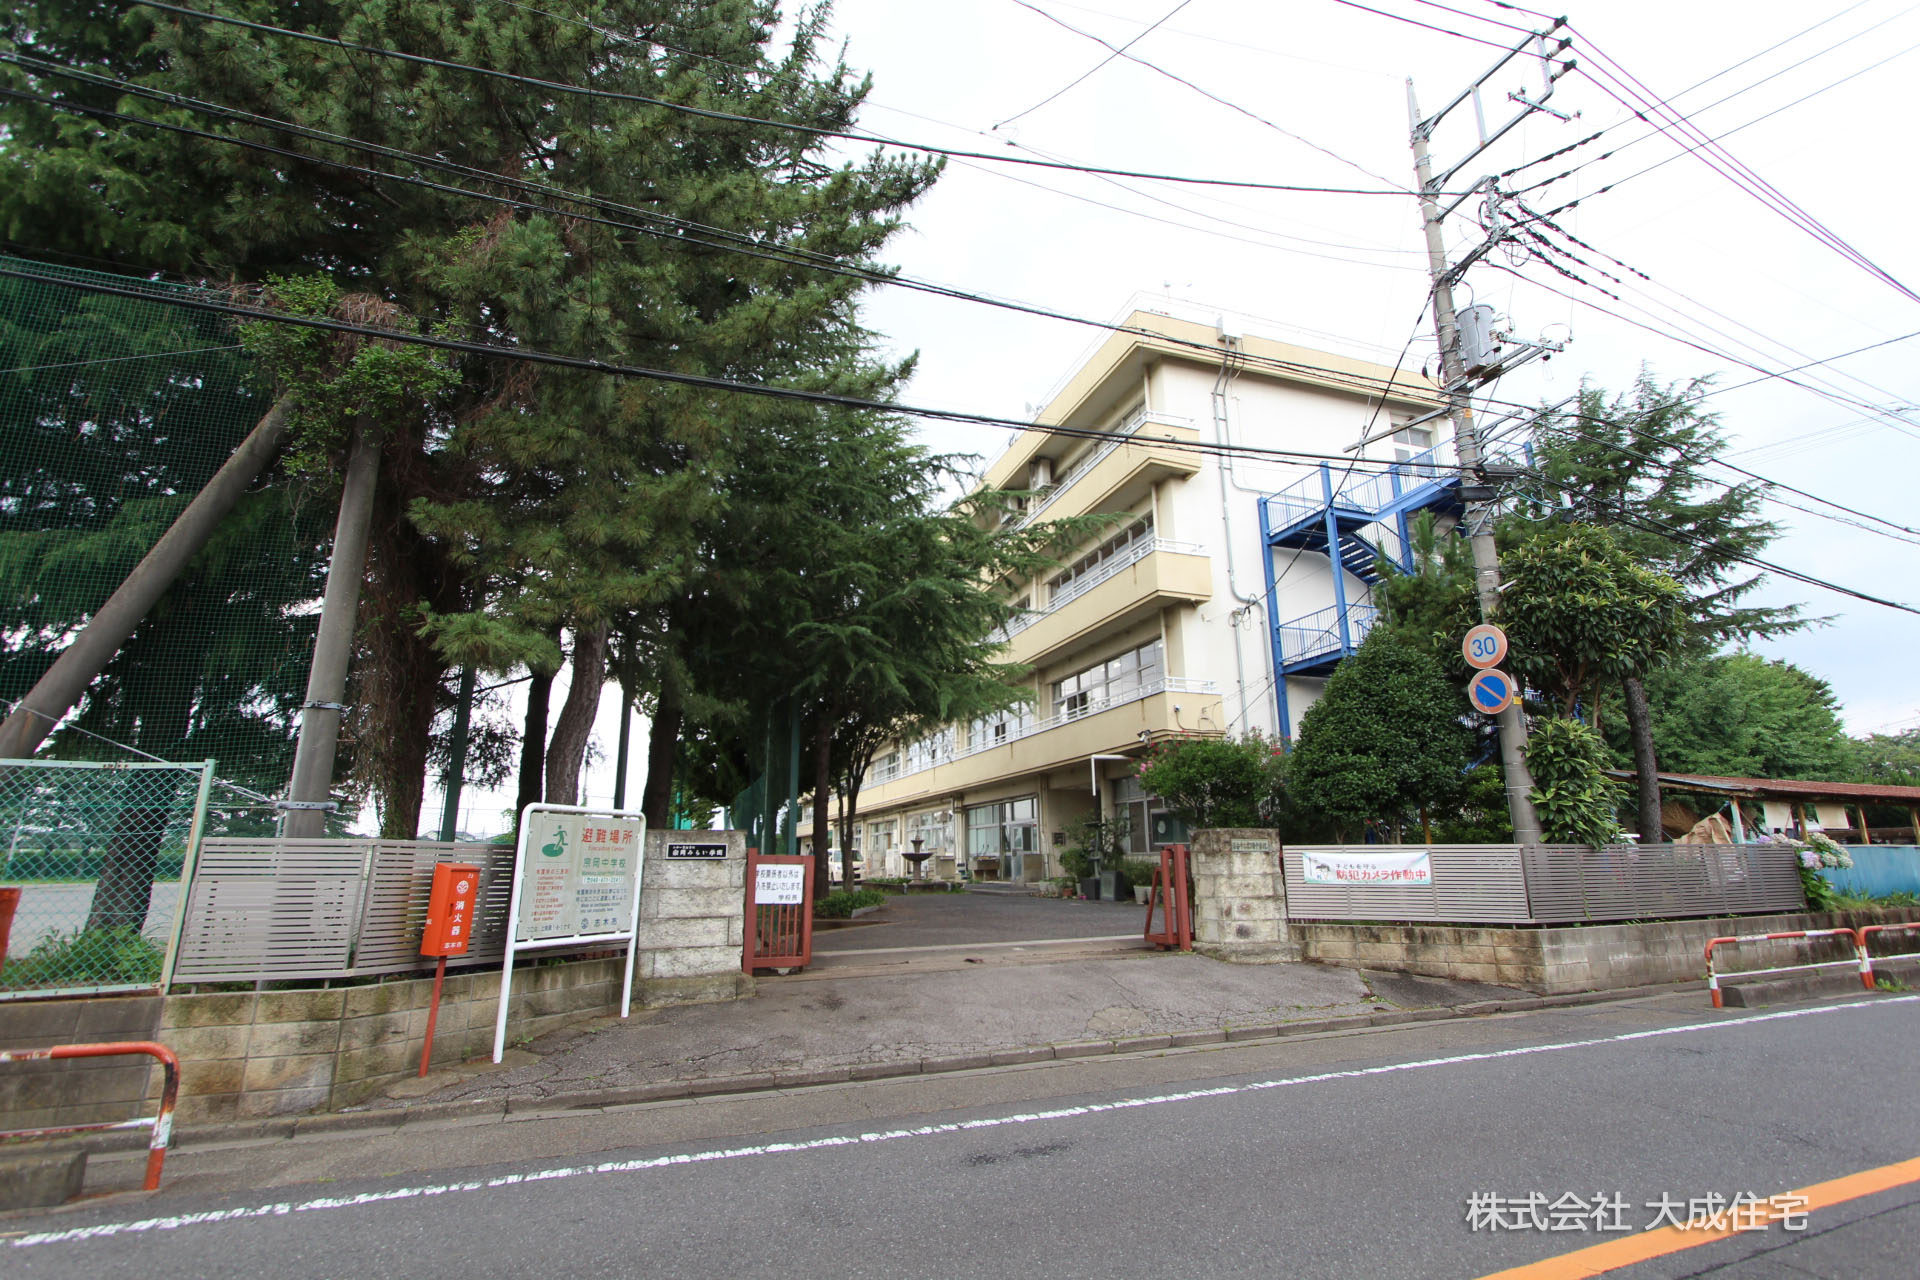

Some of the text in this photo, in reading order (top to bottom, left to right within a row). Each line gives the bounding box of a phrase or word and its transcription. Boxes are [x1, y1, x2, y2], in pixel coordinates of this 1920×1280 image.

[1472, 636, 1496, 657] 30
[582, 828, 633, 844] 避難場所
[583, 857, 626, 868] 宗岡中学校
[1336, 869, 1427, 881] 防犯カメラ作動中
[451, 900, 465, 936] 消火器
[594, 917, 617, 927] 志木市
